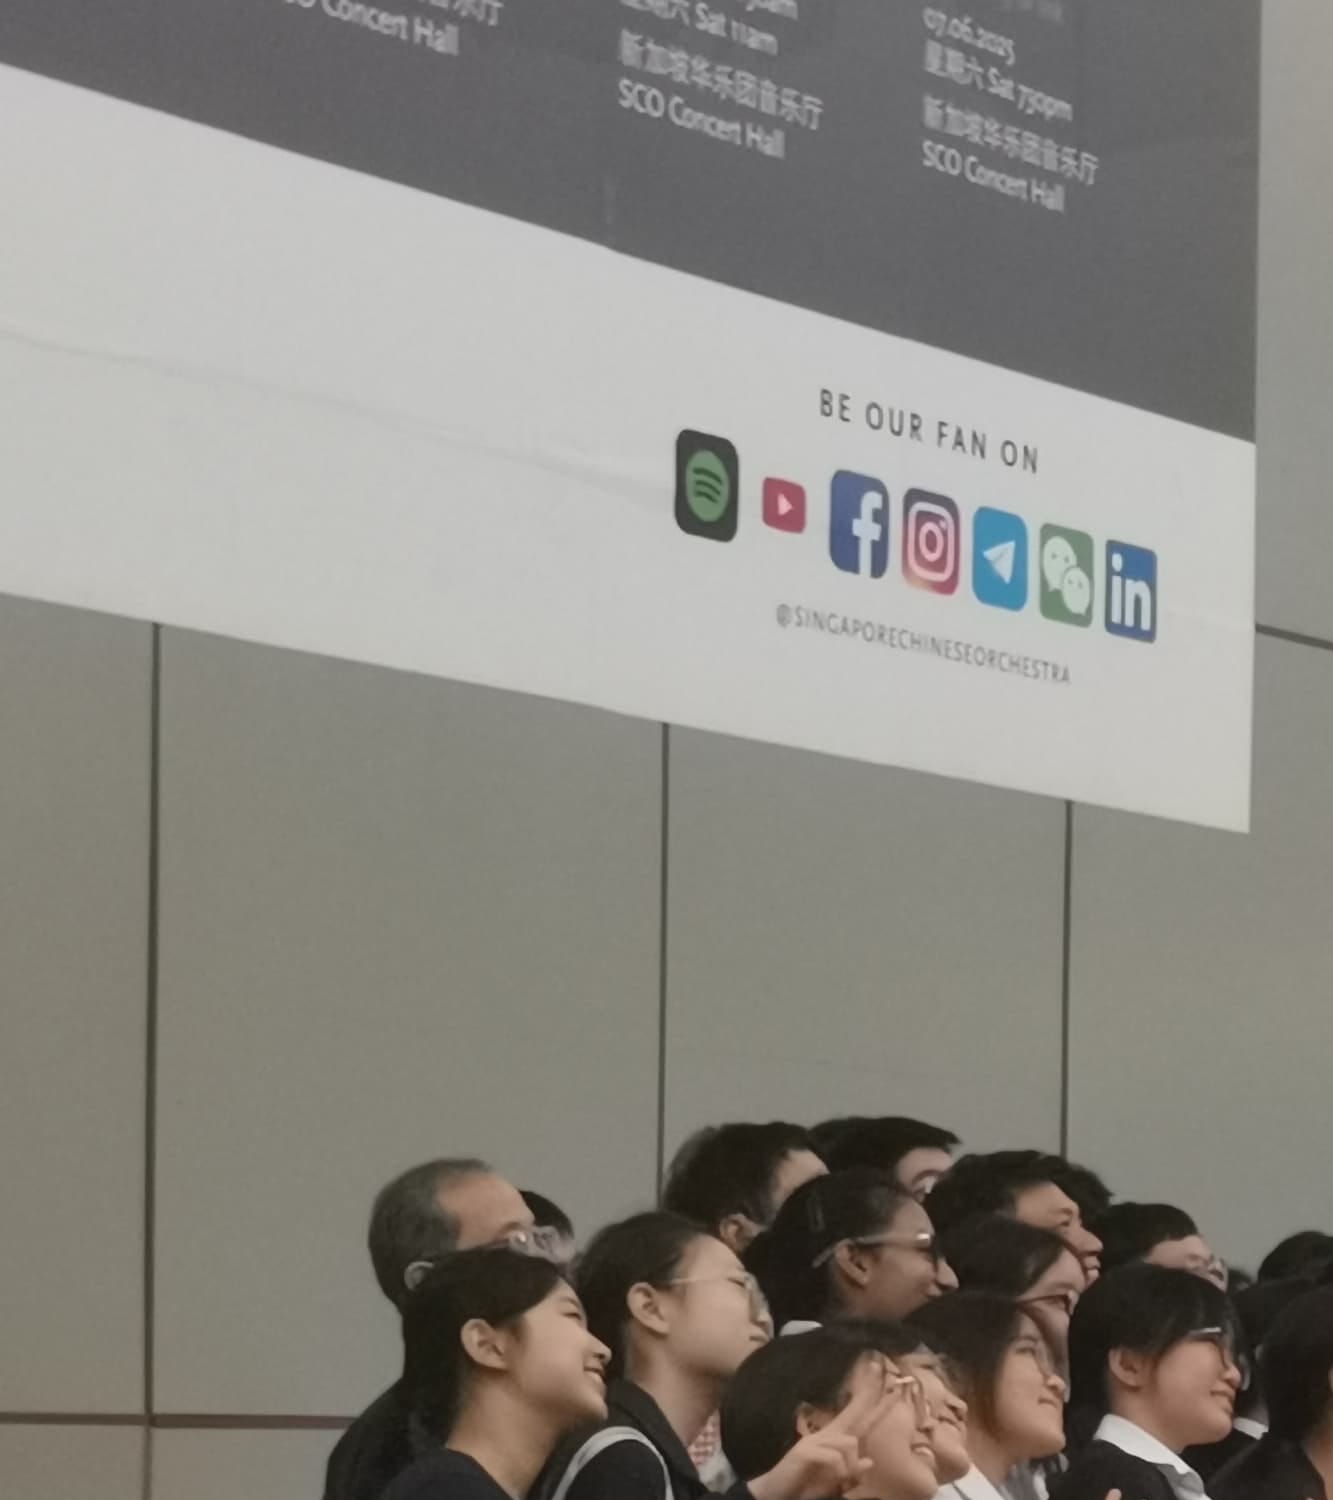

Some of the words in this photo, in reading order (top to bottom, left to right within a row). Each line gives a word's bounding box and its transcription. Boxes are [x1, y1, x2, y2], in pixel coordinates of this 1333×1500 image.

[413, 16, 459, 56] Hall
[618, 77, 664, 118] SCO
[668, 95, 742, 146] Concert
[746, 121, 786, 160] Hall
[922, 139, 962, 176] SCO
[964, 155, 1028, 200] Concert
[1031, 178, 1065, 213] Hall
[820, 387, 852, 423] BE
[865, 400, 923, 443] OUR
[938, 420, 987, 461] FAN
[1000, 438, 1039, 475] ON
[1110, 552, 1152, 632] in
[775, 603, 1071, 686] @SINGAPORECHINESEORCHESTRA
